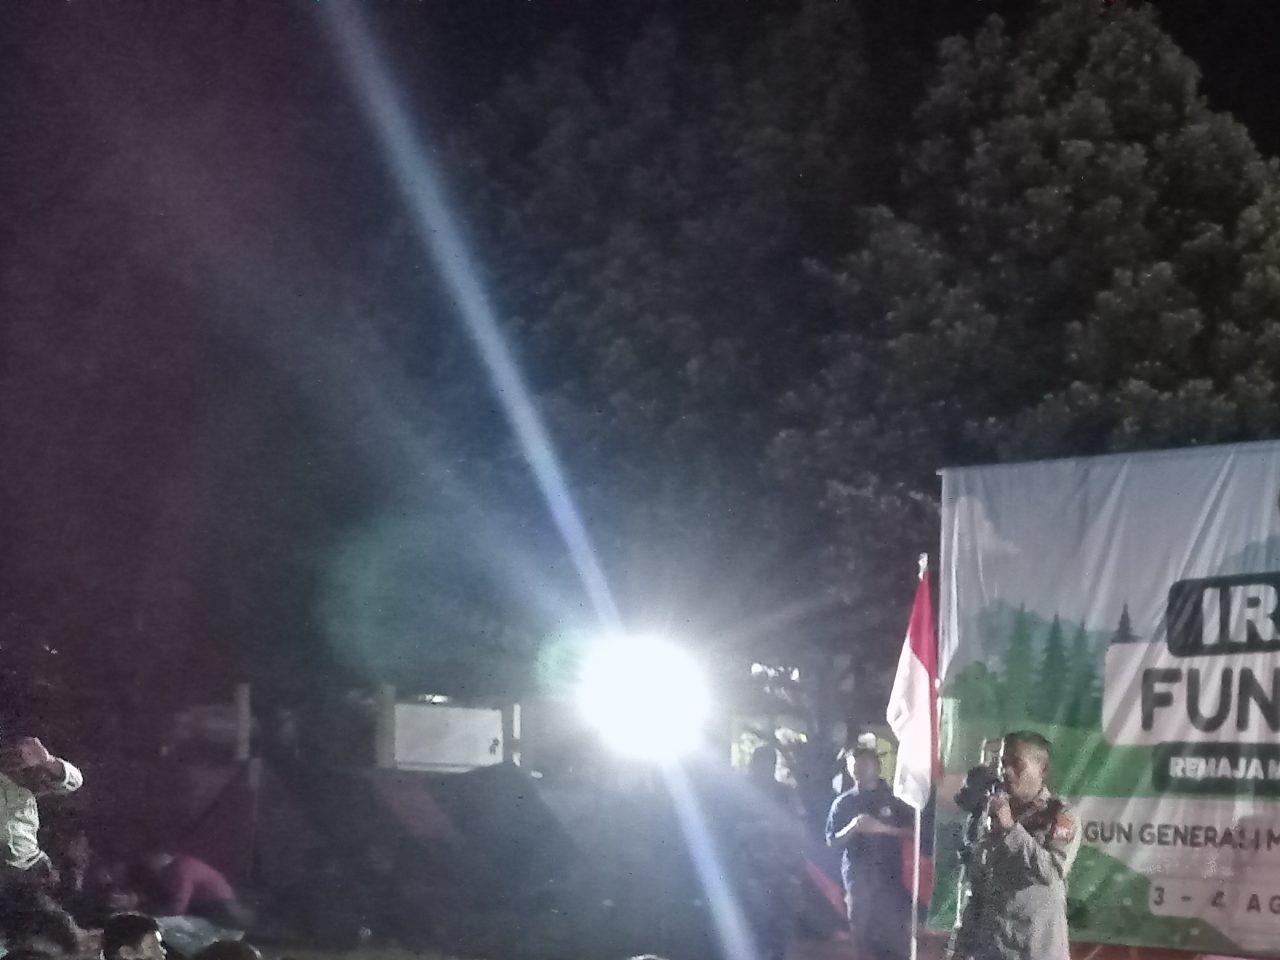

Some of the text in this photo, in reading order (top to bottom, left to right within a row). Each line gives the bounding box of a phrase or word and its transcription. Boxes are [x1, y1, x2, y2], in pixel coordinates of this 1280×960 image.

[1169, 757, 1264, 780] REMAJA
[1084, 820, 1133, 843] GUN
[1138, 822, 1260, 852] GENERASI
